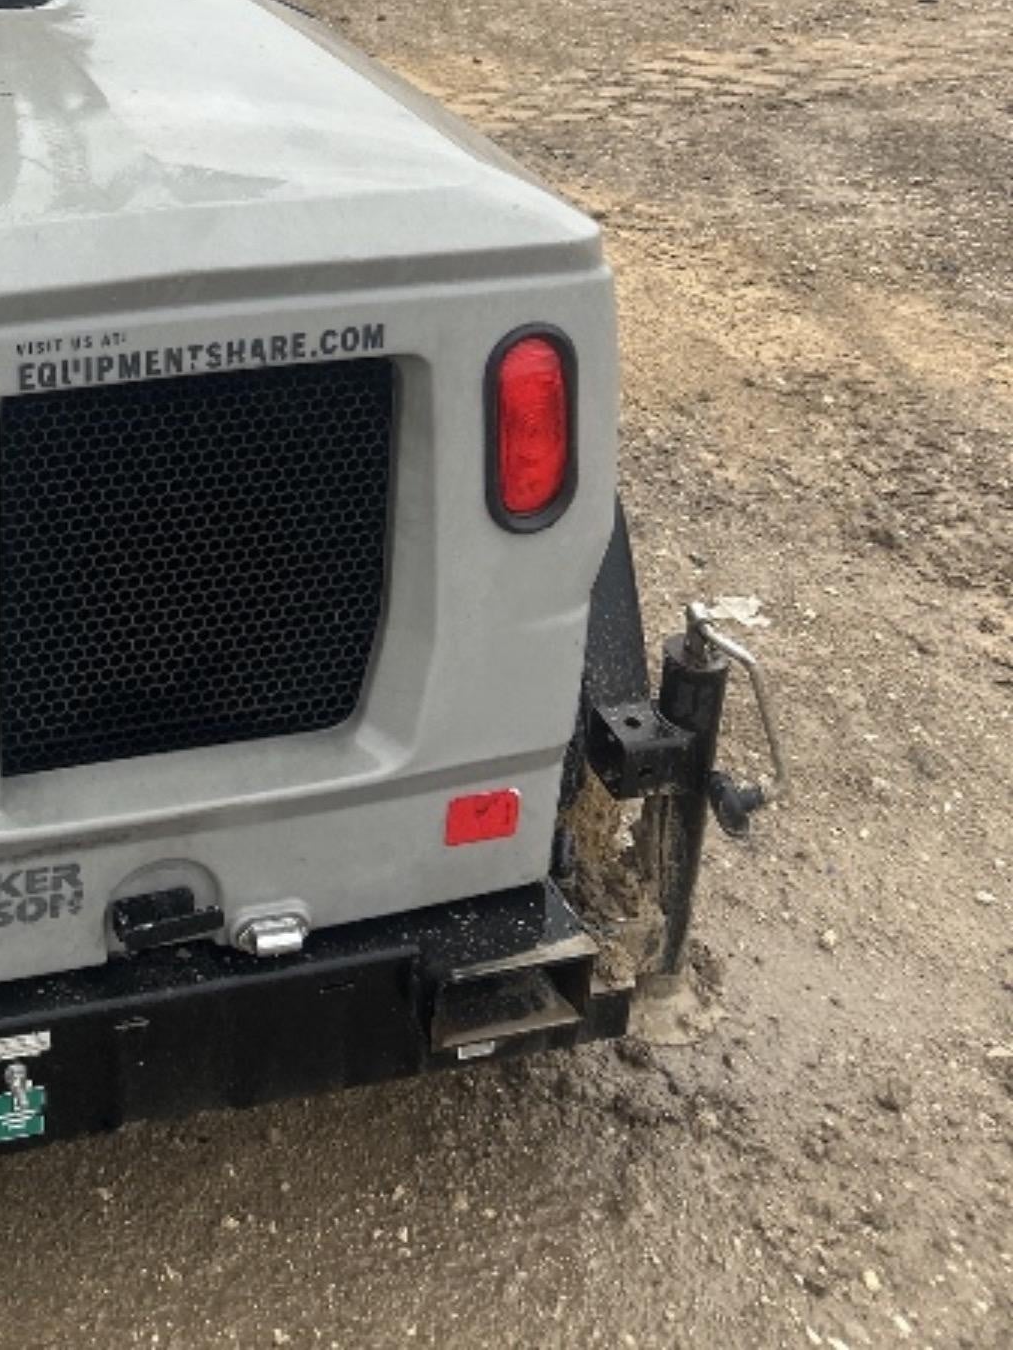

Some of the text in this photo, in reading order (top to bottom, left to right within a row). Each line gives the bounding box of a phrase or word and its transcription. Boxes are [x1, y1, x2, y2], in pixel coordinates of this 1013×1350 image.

[16, 331, 127, 356] VISIT US AT:
[18, 323, 386, 391] EQUIPMENTSHARE.COM
